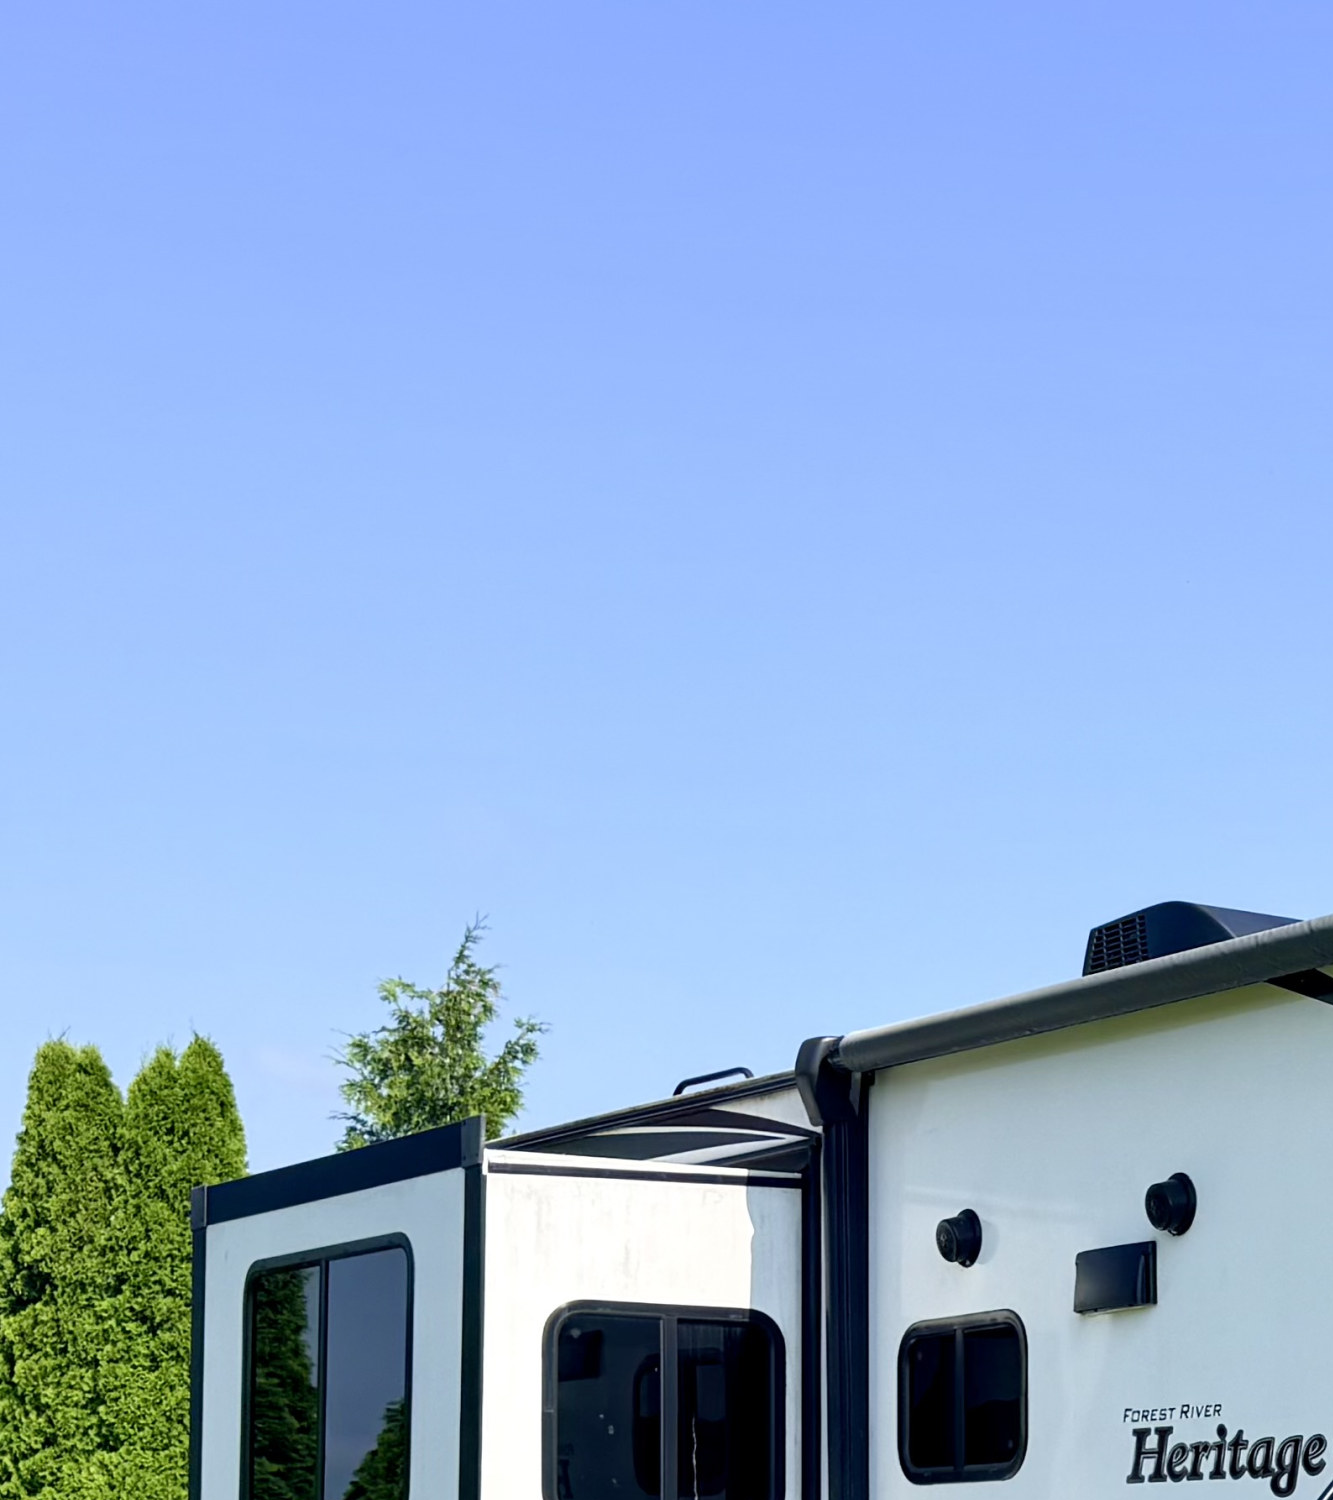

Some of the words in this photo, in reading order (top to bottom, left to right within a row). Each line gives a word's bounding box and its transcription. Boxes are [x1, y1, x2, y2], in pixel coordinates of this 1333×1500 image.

[1123, 1407, 1177, 1423] FOREST
[1180, 1403, 1223, 1419] RIVER
[1126, 1423, 1328, 1498] Heritage
